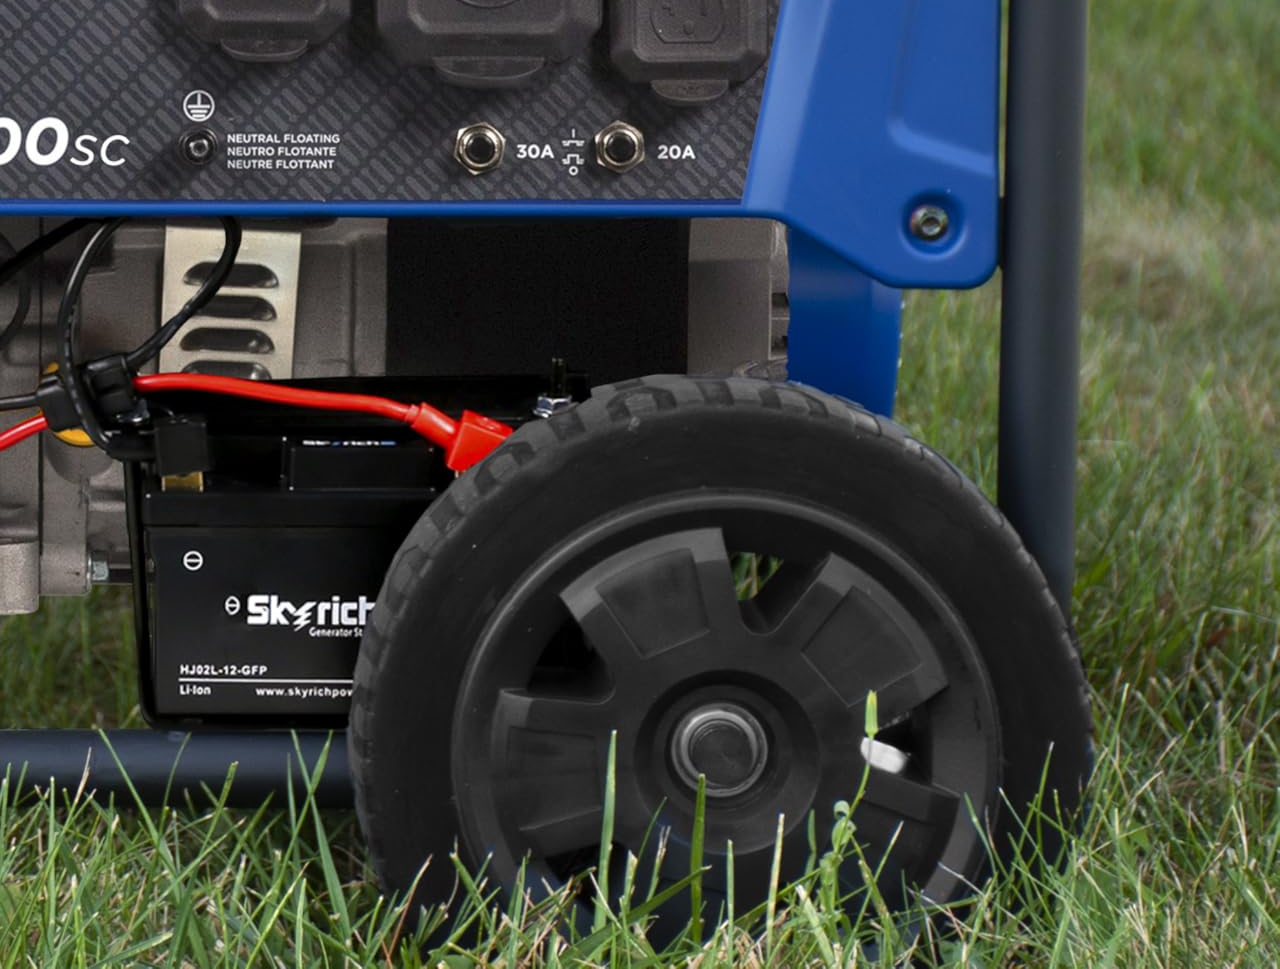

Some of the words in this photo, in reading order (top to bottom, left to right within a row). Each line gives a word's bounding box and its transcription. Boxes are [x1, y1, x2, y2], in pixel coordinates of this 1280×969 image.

[227, 134, 280, 143] NEUTRAL
[284, 134, 340, 143] FLOATING
[227, 147, 274, 156] NEUTRO
[278, 147, 336, 156] FLOTANTE
[517, 144, 554, 158] 30A
[658, 146, 696, 160] 20A
[227, 160, 272, 169] NEUTRE
[276, 160, 334, 169] FLOTTANT
[309, 628, 352, 637] Generator
[180, 665, 268, 676] HJ02L-12-GFP
